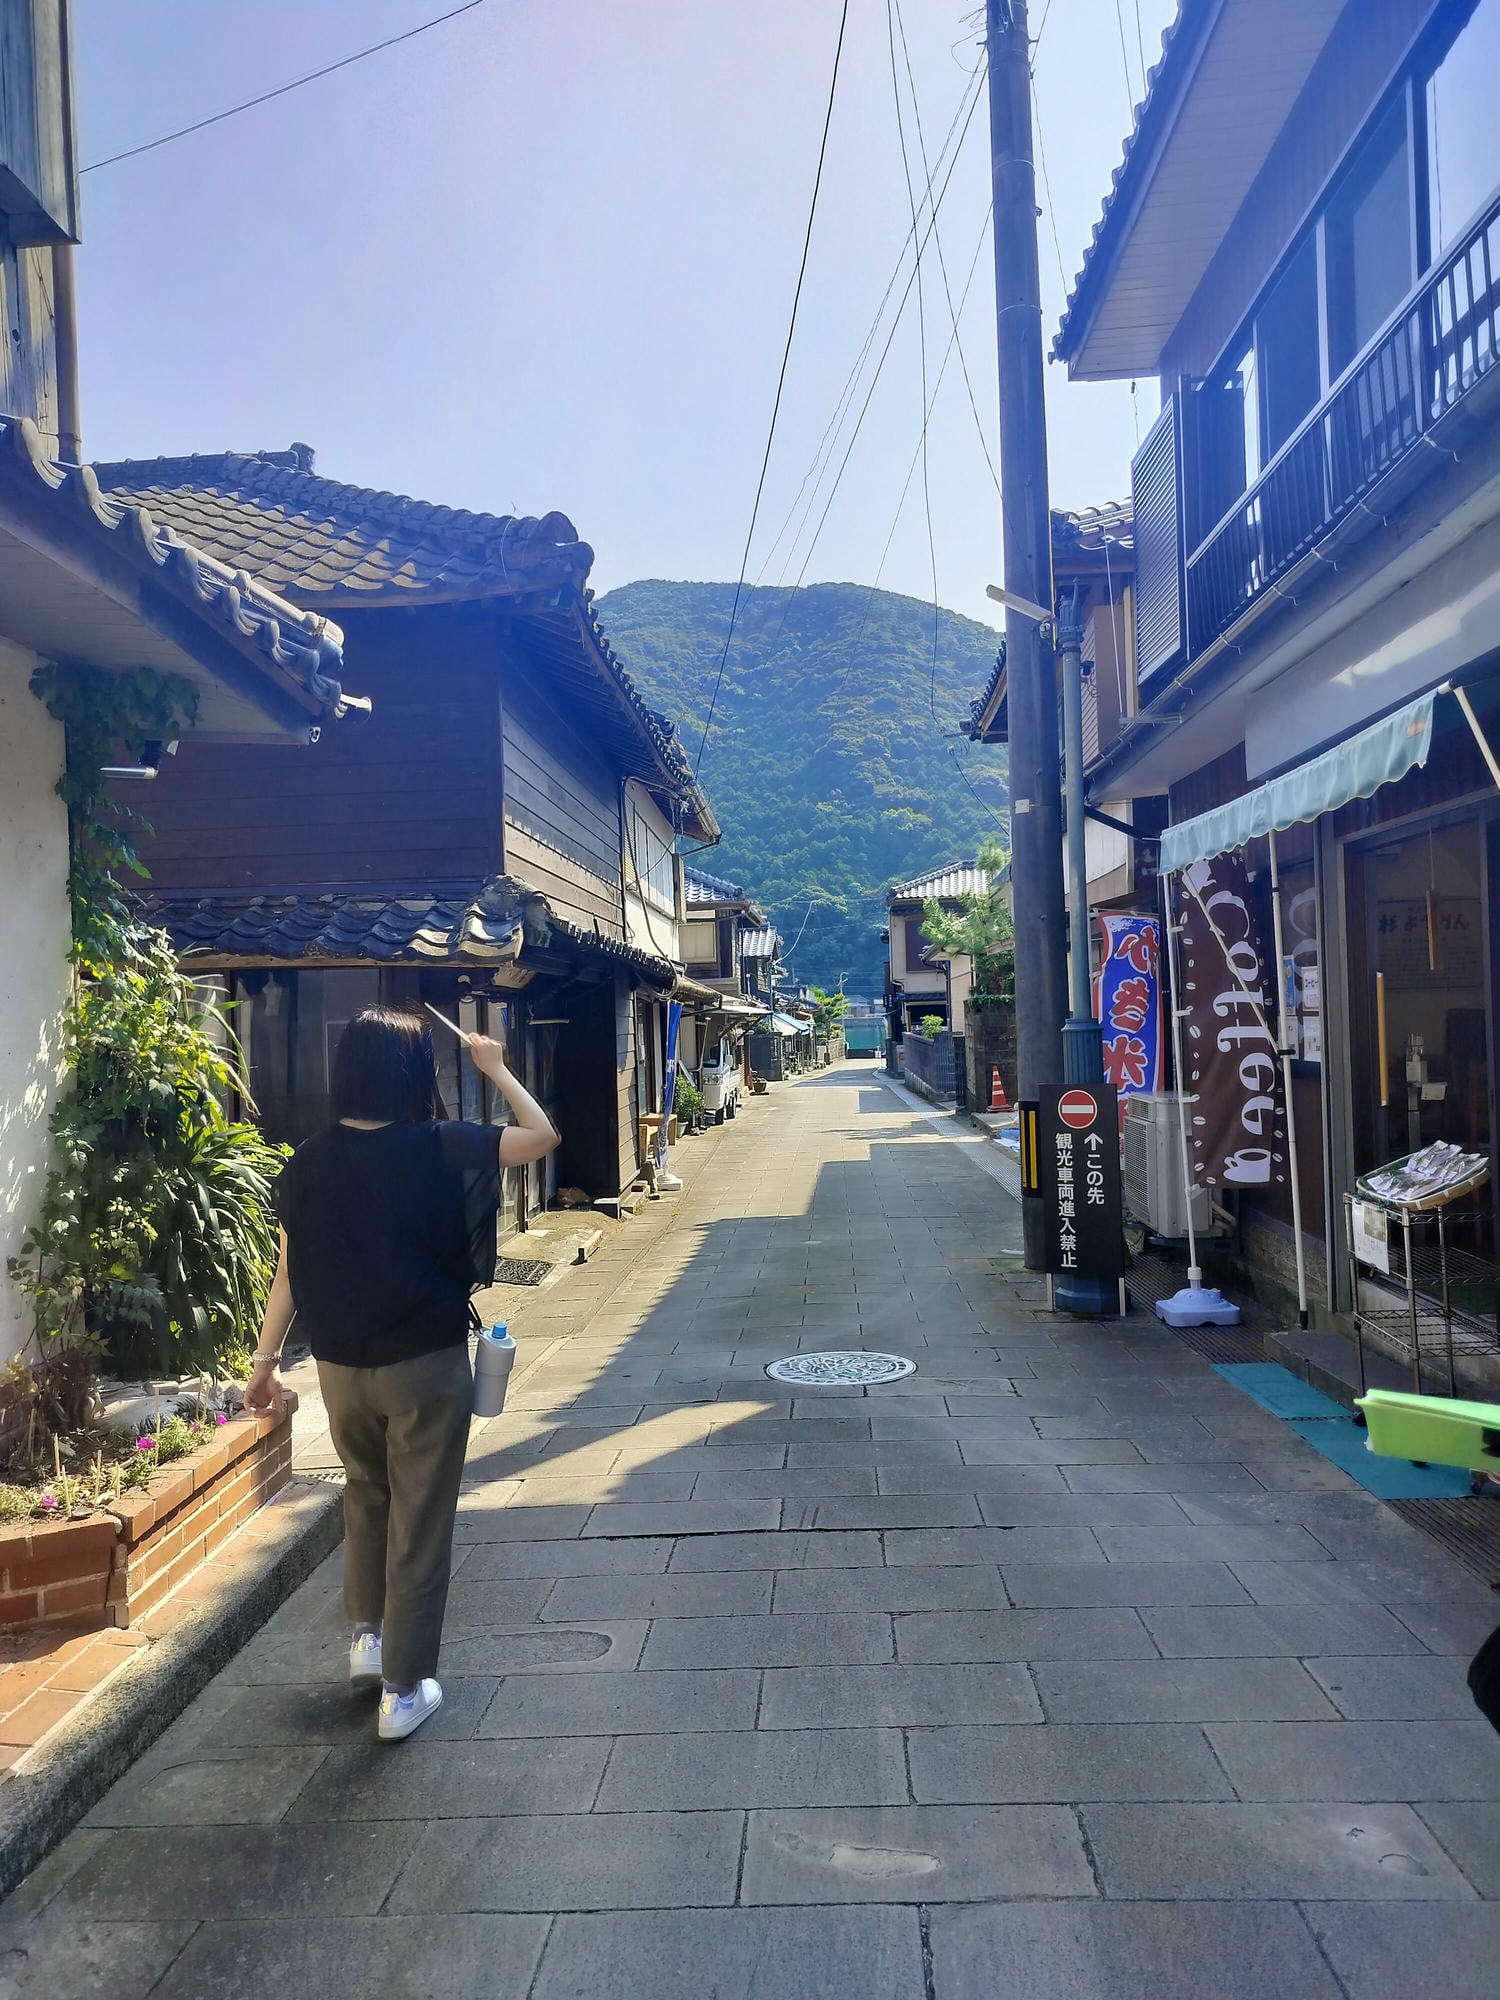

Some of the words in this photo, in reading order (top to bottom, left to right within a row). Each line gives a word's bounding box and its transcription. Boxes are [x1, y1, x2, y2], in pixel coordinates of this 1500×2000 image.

[1055, 1132, 1078, 1268] 観光車両進入禁止
[1086, 1153, 1105, 1205] この先
